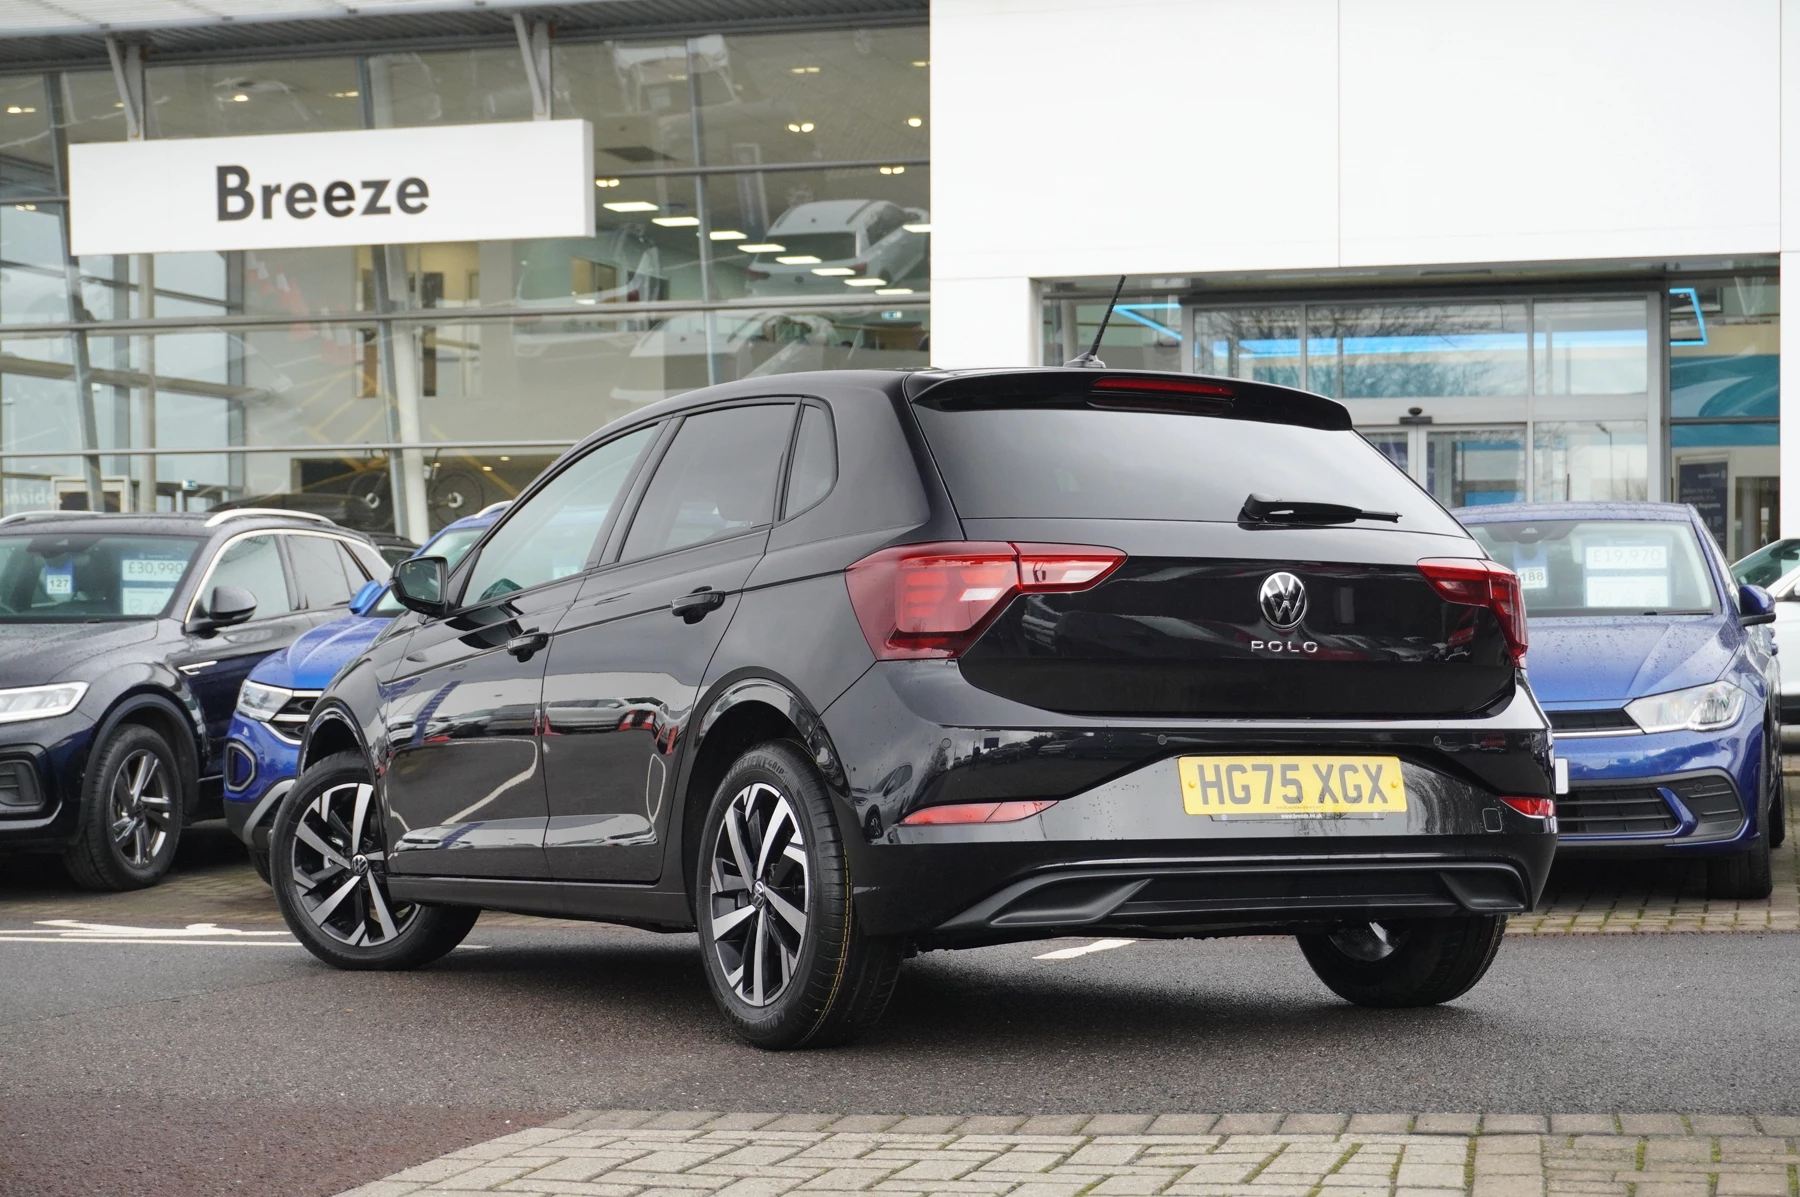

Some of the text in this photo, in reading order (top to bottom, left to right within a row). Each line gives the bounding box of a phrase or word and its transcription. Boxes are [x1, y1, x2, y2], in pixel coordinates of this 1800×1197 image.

[216, 165, 429, 222] Breeze
[128, 561, 183, 576] £30,990
[50, 579, 69, 588] 127
[1521, 572, 1544, 582] 188
[1250, 640, 1318, 654] POLO
[1197, 763, 1389, 805] HG75 XGX
